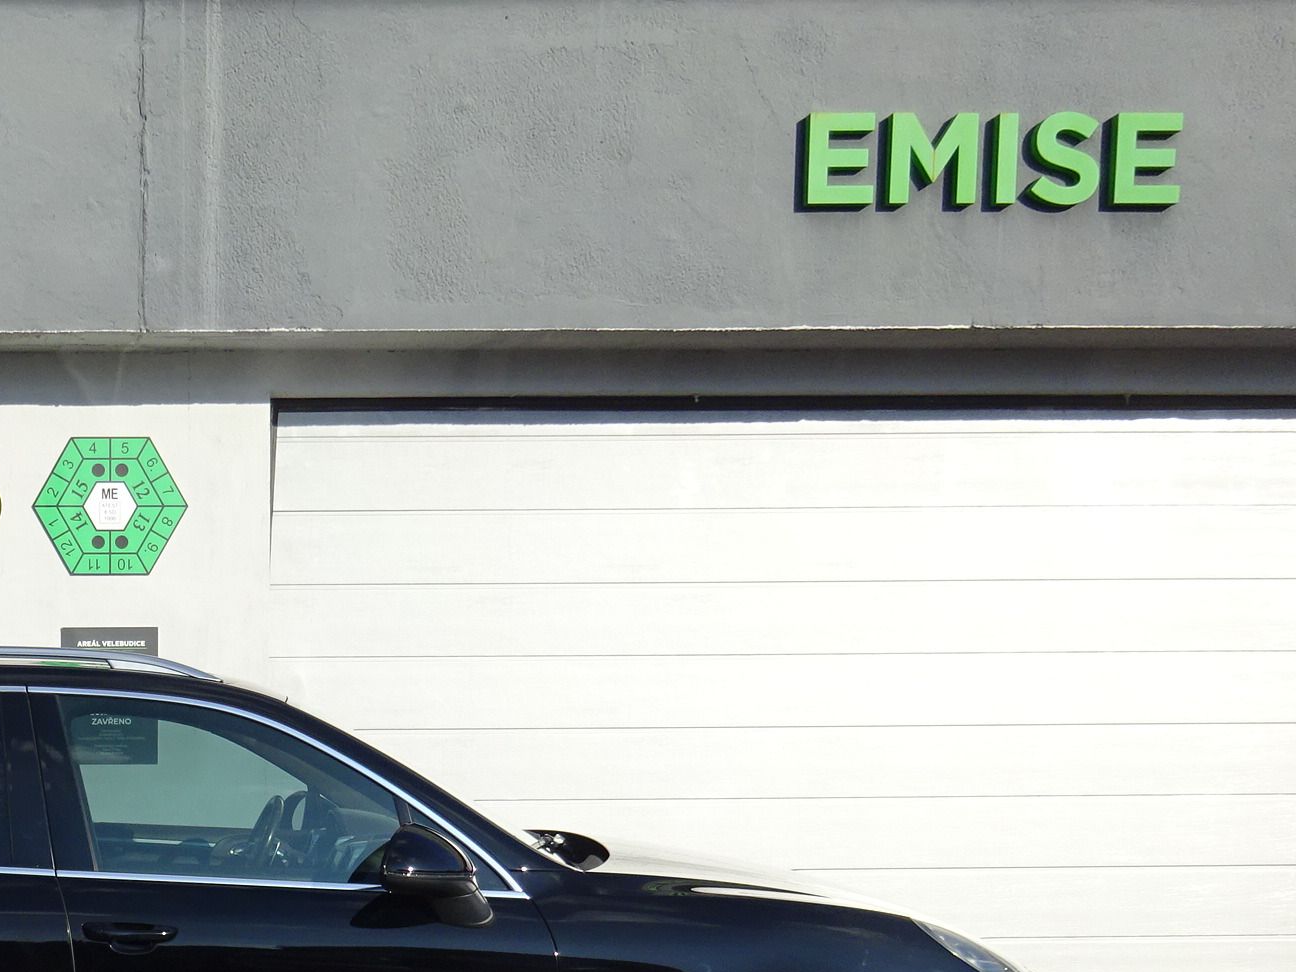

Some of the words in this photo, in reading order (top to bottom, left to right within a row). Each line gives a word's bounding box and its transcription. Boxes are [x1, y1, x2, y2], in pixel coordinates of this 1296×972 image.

[798, 111, 1185, 208] EMISE
[88, 442, 97, 454] 4
[120, 442, 129, 454] 5
[62, 459, 75, 470] 3
[46, 487, 59, 498] 2
[71, 479, 89, 499] 15
[101, 488, 119, 500] ME
[132, 480, 151, 499] 12
[162, 487, 175, 495] 7
[48, 518, 59, 527] 1
[70, 511, 89, 531] 14
[132, 511, 151, 532] 13
[161, 516, 174, 527] 8
[60, 538, 76, 557] 12
[88, 558, 100, 570] 11
[117, 558, 133, 570] 10
[91, 716, 132, 726] ZAVŘENO
